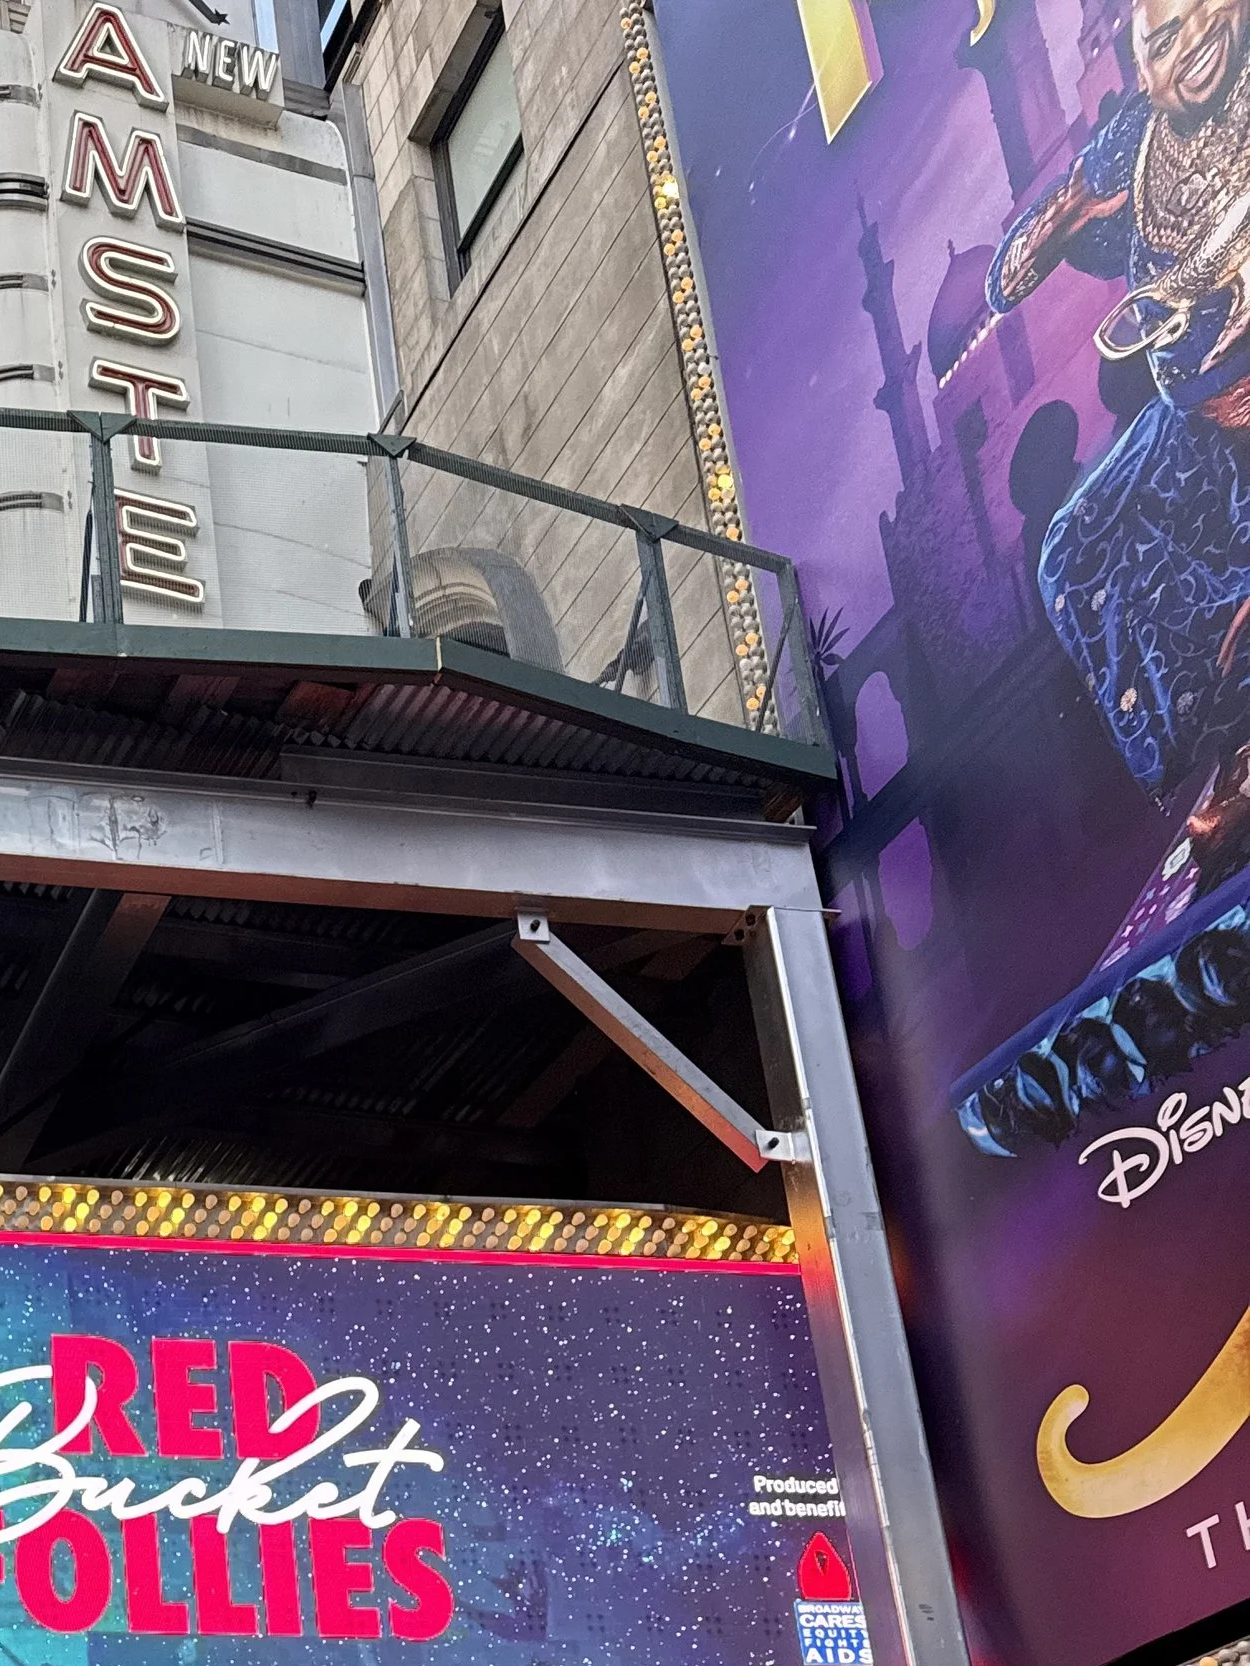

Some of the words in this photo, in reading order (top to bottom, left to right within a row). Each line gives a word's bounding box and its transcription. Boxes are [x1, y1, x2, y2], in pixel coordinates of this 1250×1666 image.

[187, 31, 278, 95] NEW
[51, 1334, 322, 1460] RED
[753, 1475, 840, 1495] Produced
[749, 1499, 783, 1517] and
[799, 1613, 867, 1629] CARES
[805, 1647, 874, 1665] AIDS
